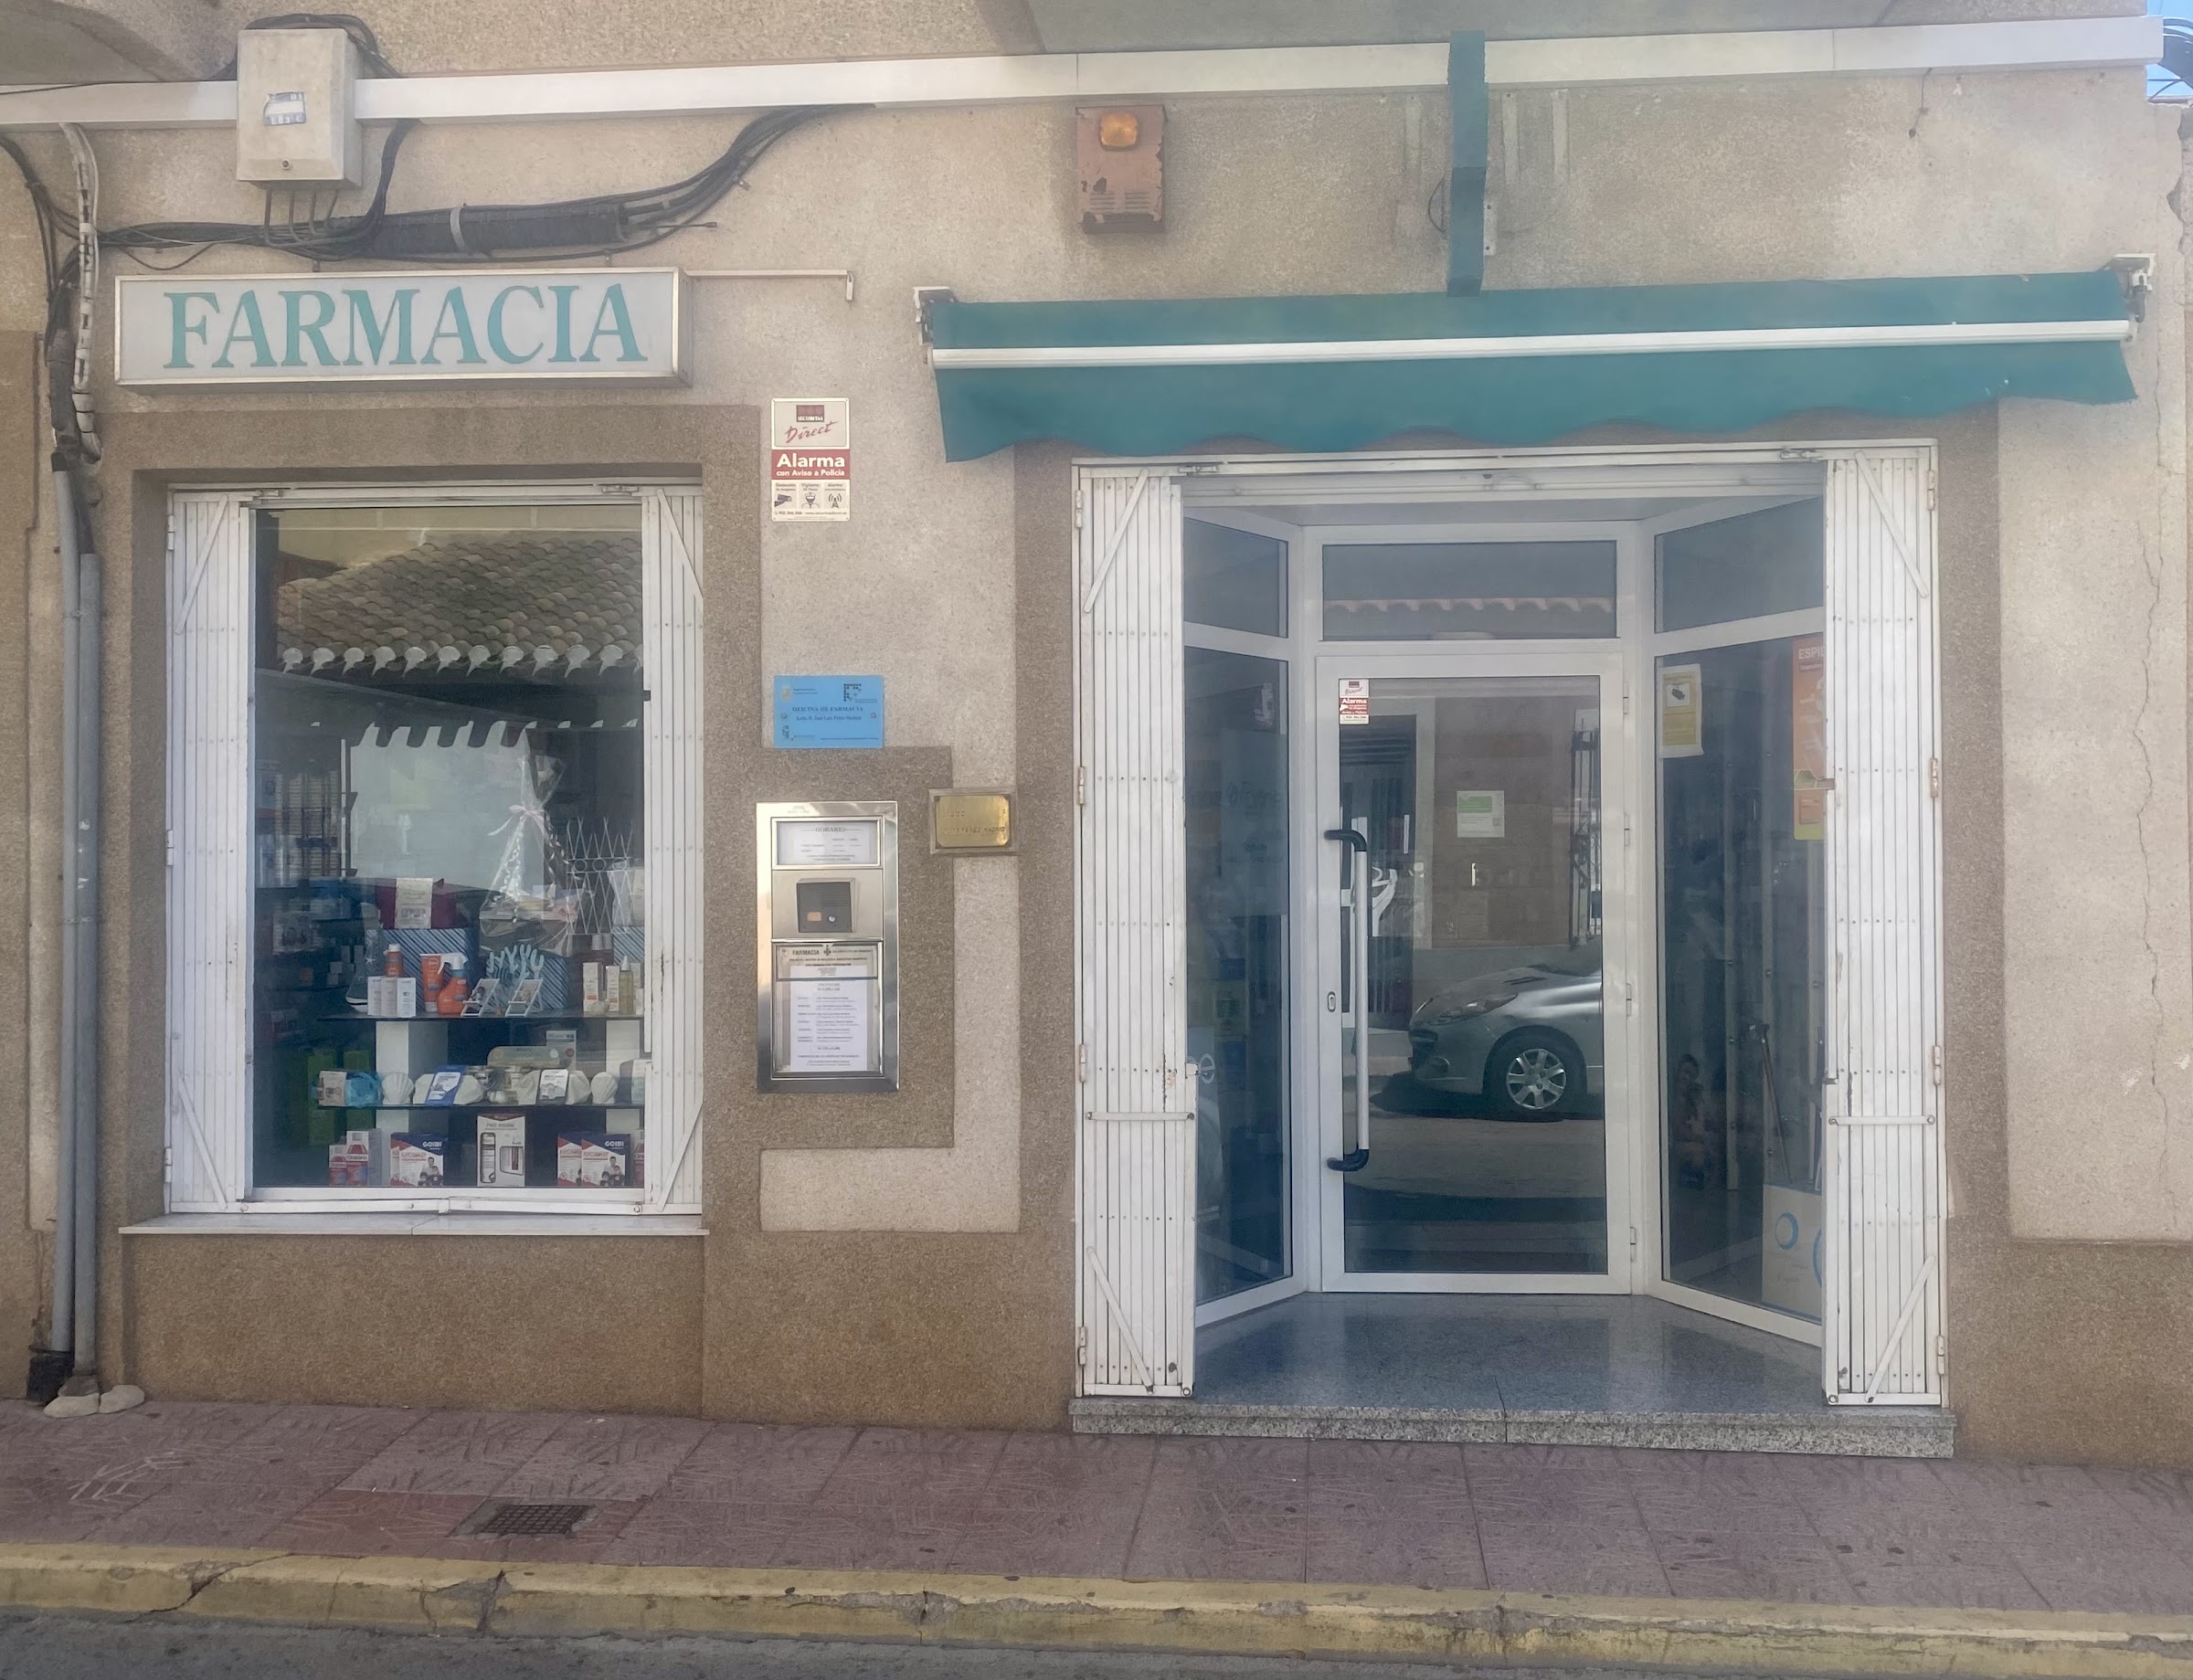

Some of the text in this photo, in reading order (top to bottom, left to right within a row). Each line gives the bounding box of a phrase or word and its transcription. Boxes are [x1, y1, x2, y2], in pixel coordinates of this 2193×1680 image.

[163, 282, 648, 368] FARMACIA
[784, 420, 839, 444] Direct
[776, 452, 845, 468] Alarma
[791, 469, 812, 477] Aviso
